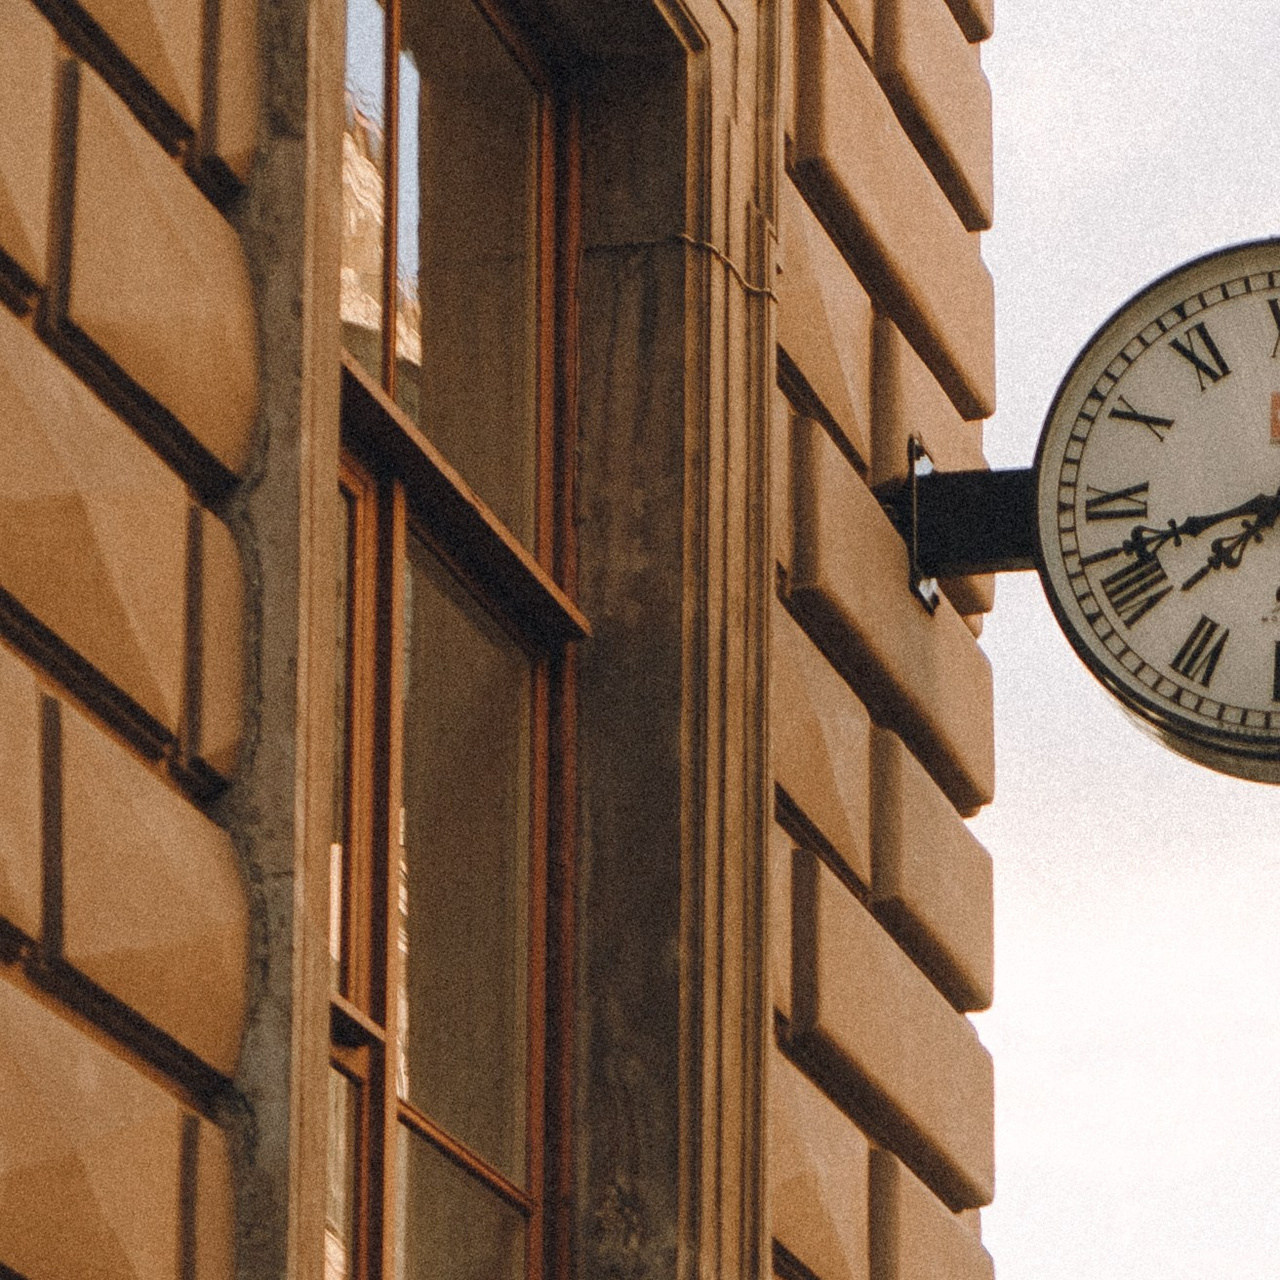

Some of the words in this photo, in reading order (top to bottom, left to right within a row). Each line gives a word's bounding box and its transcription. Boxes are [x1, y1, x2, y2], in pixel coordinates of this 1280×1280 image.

[1168, 321, 1232, 391] XI
[1109, 395, 1175, 442] X
[1086, 481, 1149, 522] IX
[1100, 554, 1175, 629] VIII
[1169, 614, 1230, 688] VII
